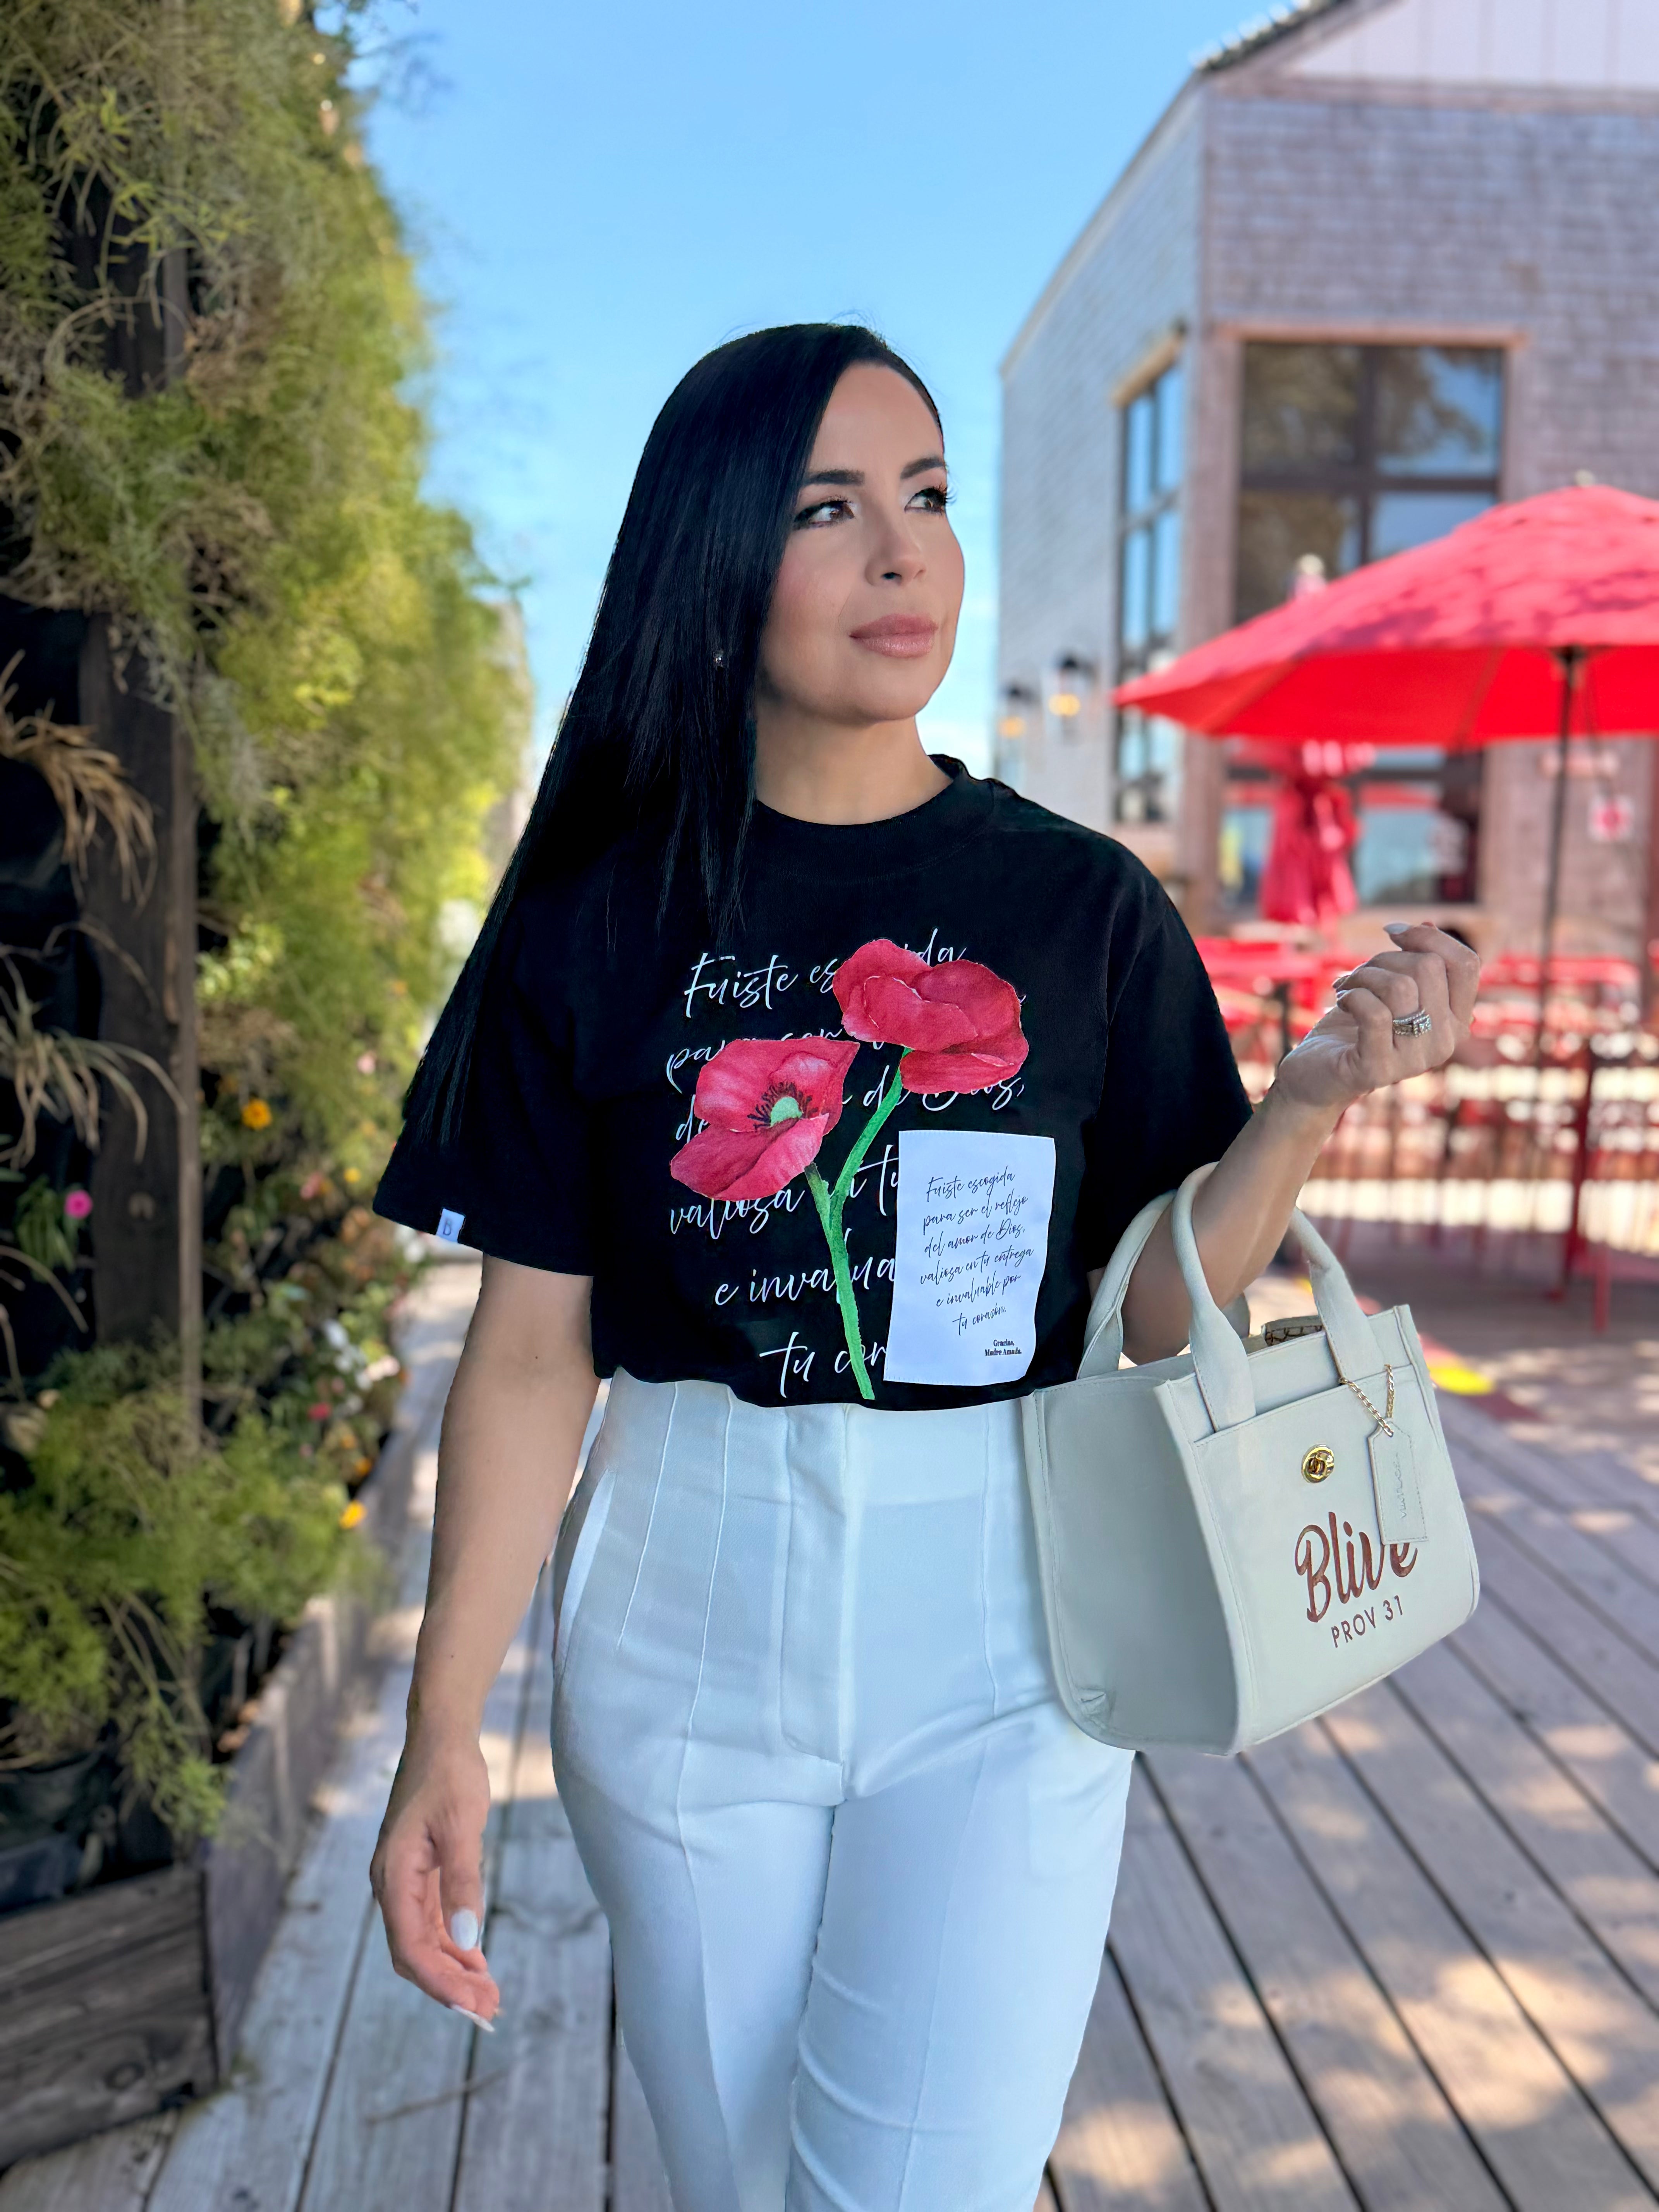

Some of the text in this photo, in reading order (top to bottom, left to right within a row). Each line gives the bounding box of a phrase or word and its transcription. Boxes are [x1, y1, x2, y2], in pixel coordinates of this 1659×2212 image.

[684, 952, 798, 1018] Fuiste
[926, 1165, 1016, 1202] Fuiste escogida
[923, 1188, 1029, 1236] para ser el reflejo
[924, 1218, 1025, 1258] del amor de Dios,
[920, 1245, 1035, 1285] valiosa en tu entrega
[714, 1283, 738, 1305] e
[936, 1270, 1022, 1307] e invaluable por
[952, 1302, 1006, 1336] tu corazón.
[759, 1331, 816, 1399] tu
[984, 1348, 1002, 1357] Madre
[1331, 1595, 1403, 1648] PROV 31
